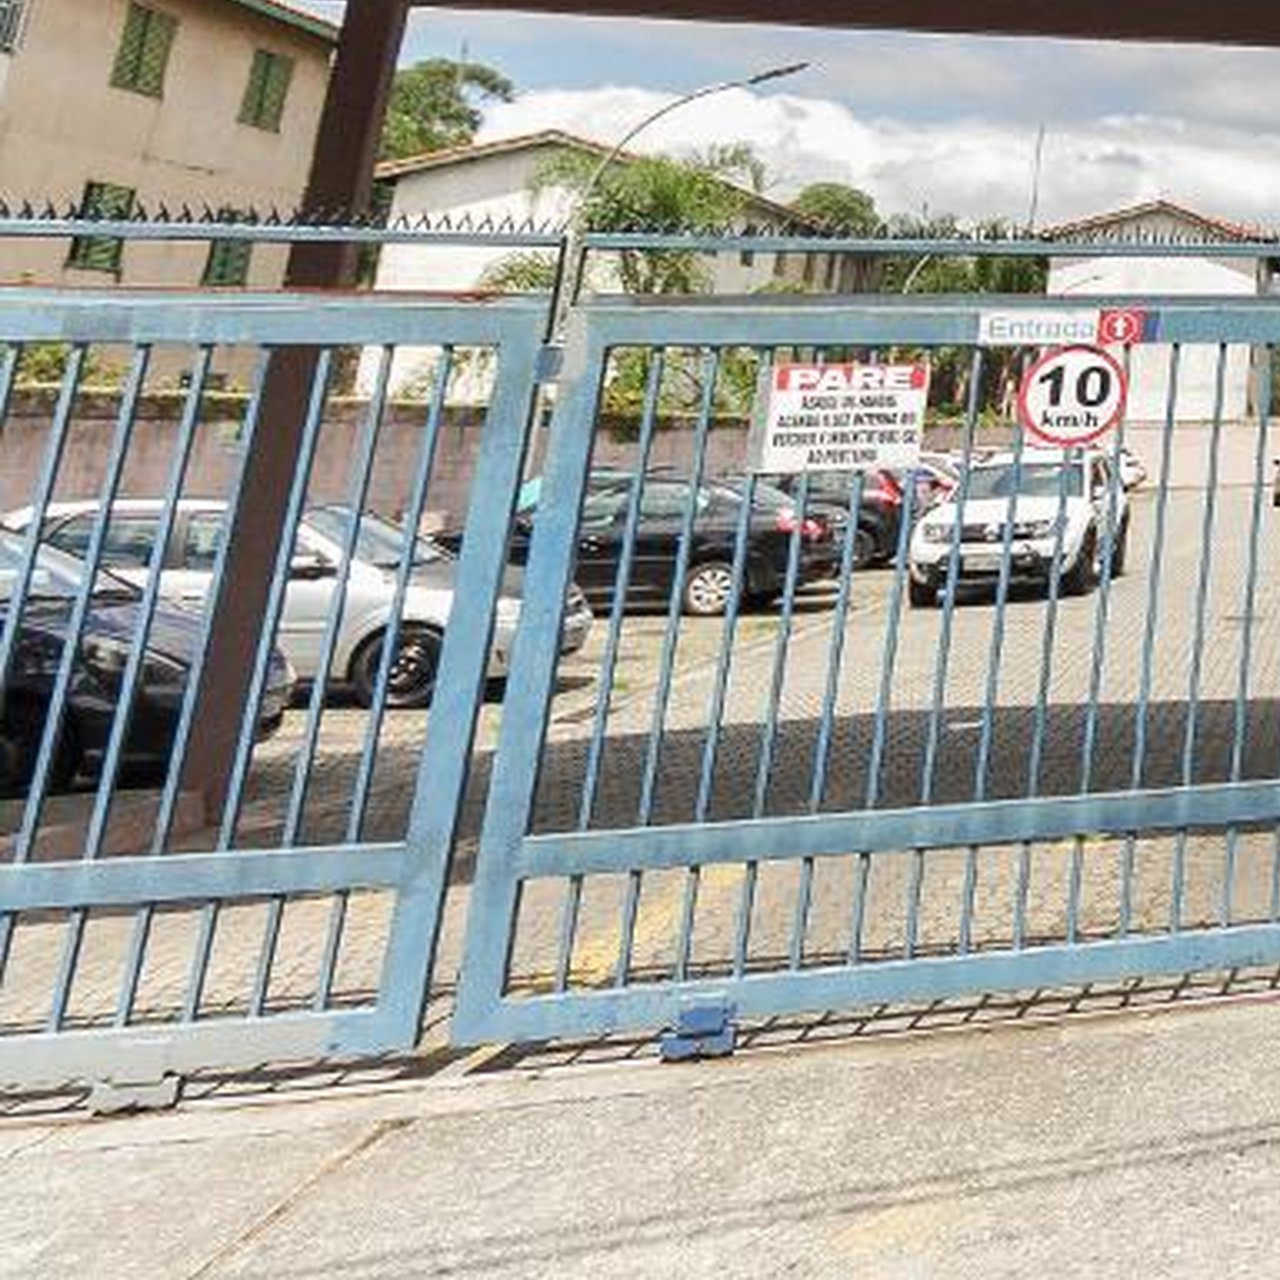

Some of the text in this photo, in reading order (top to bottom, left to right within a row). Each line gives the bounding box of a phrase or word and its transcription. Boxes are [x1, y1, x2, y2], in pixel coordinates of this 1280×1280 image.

[988, 316, 1095, 339] Entrada
[789, 366, 912, 391] PARE
[1038, 365, 1112, 408] 10
[1040, 410, 1099, 428] km/h
